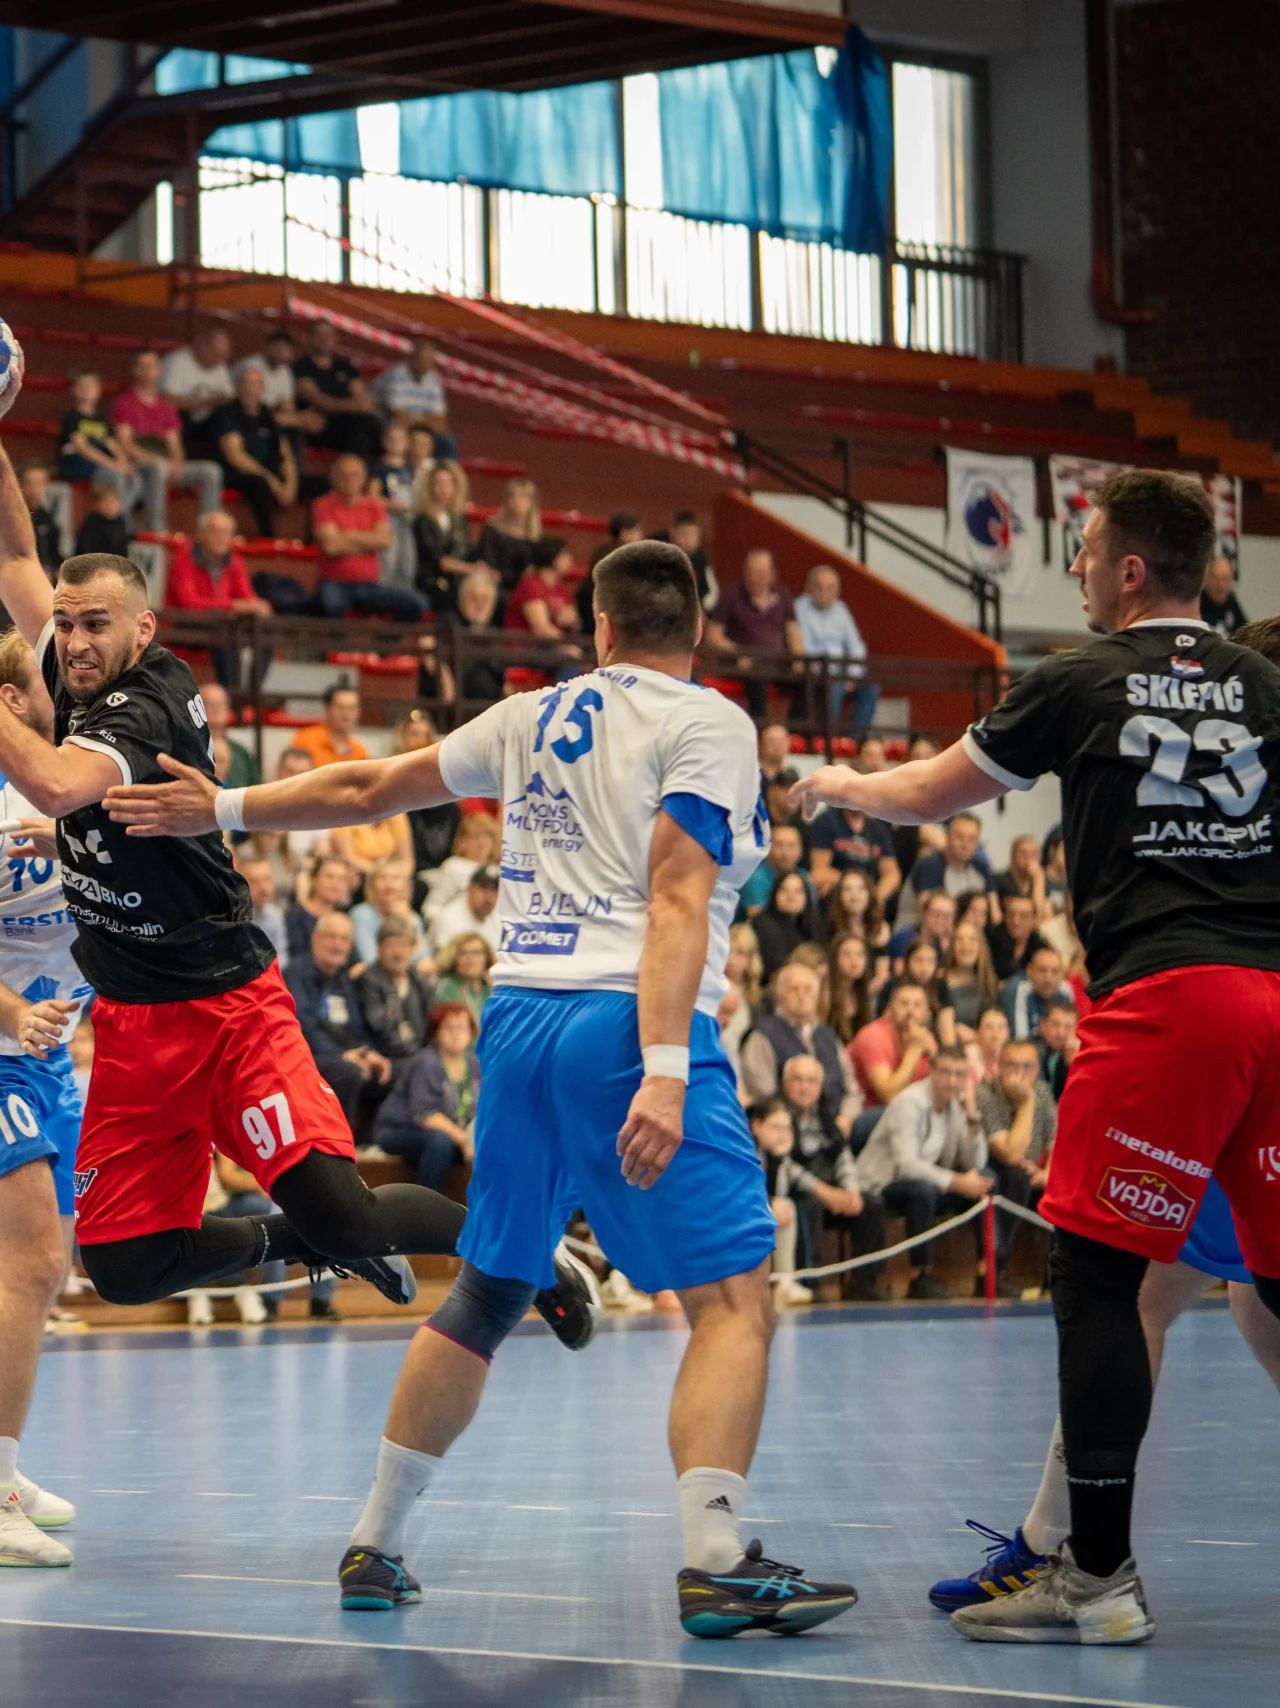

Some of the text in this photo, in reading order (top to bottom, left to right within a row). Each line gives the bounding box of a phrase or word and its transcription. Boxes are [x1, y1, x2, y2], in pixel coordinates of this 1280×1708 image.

[1126, 674, 1244, 713] SKLEPIĆ
[532, 686, 604, 764] 15
[1119, 714, 1268, 817] 23
[542, 837, 584, 852] energy
[1132, 814, 1273, 844] JAKOPIĆ
[7, 856, 54, 893] 10
[4, 926, 37, 937] Bank
[517, 930, 574, 947] COMET
[241, 1091, 297, 1160] 97
[1109, 1175, 1186, 1225] VAJDA
